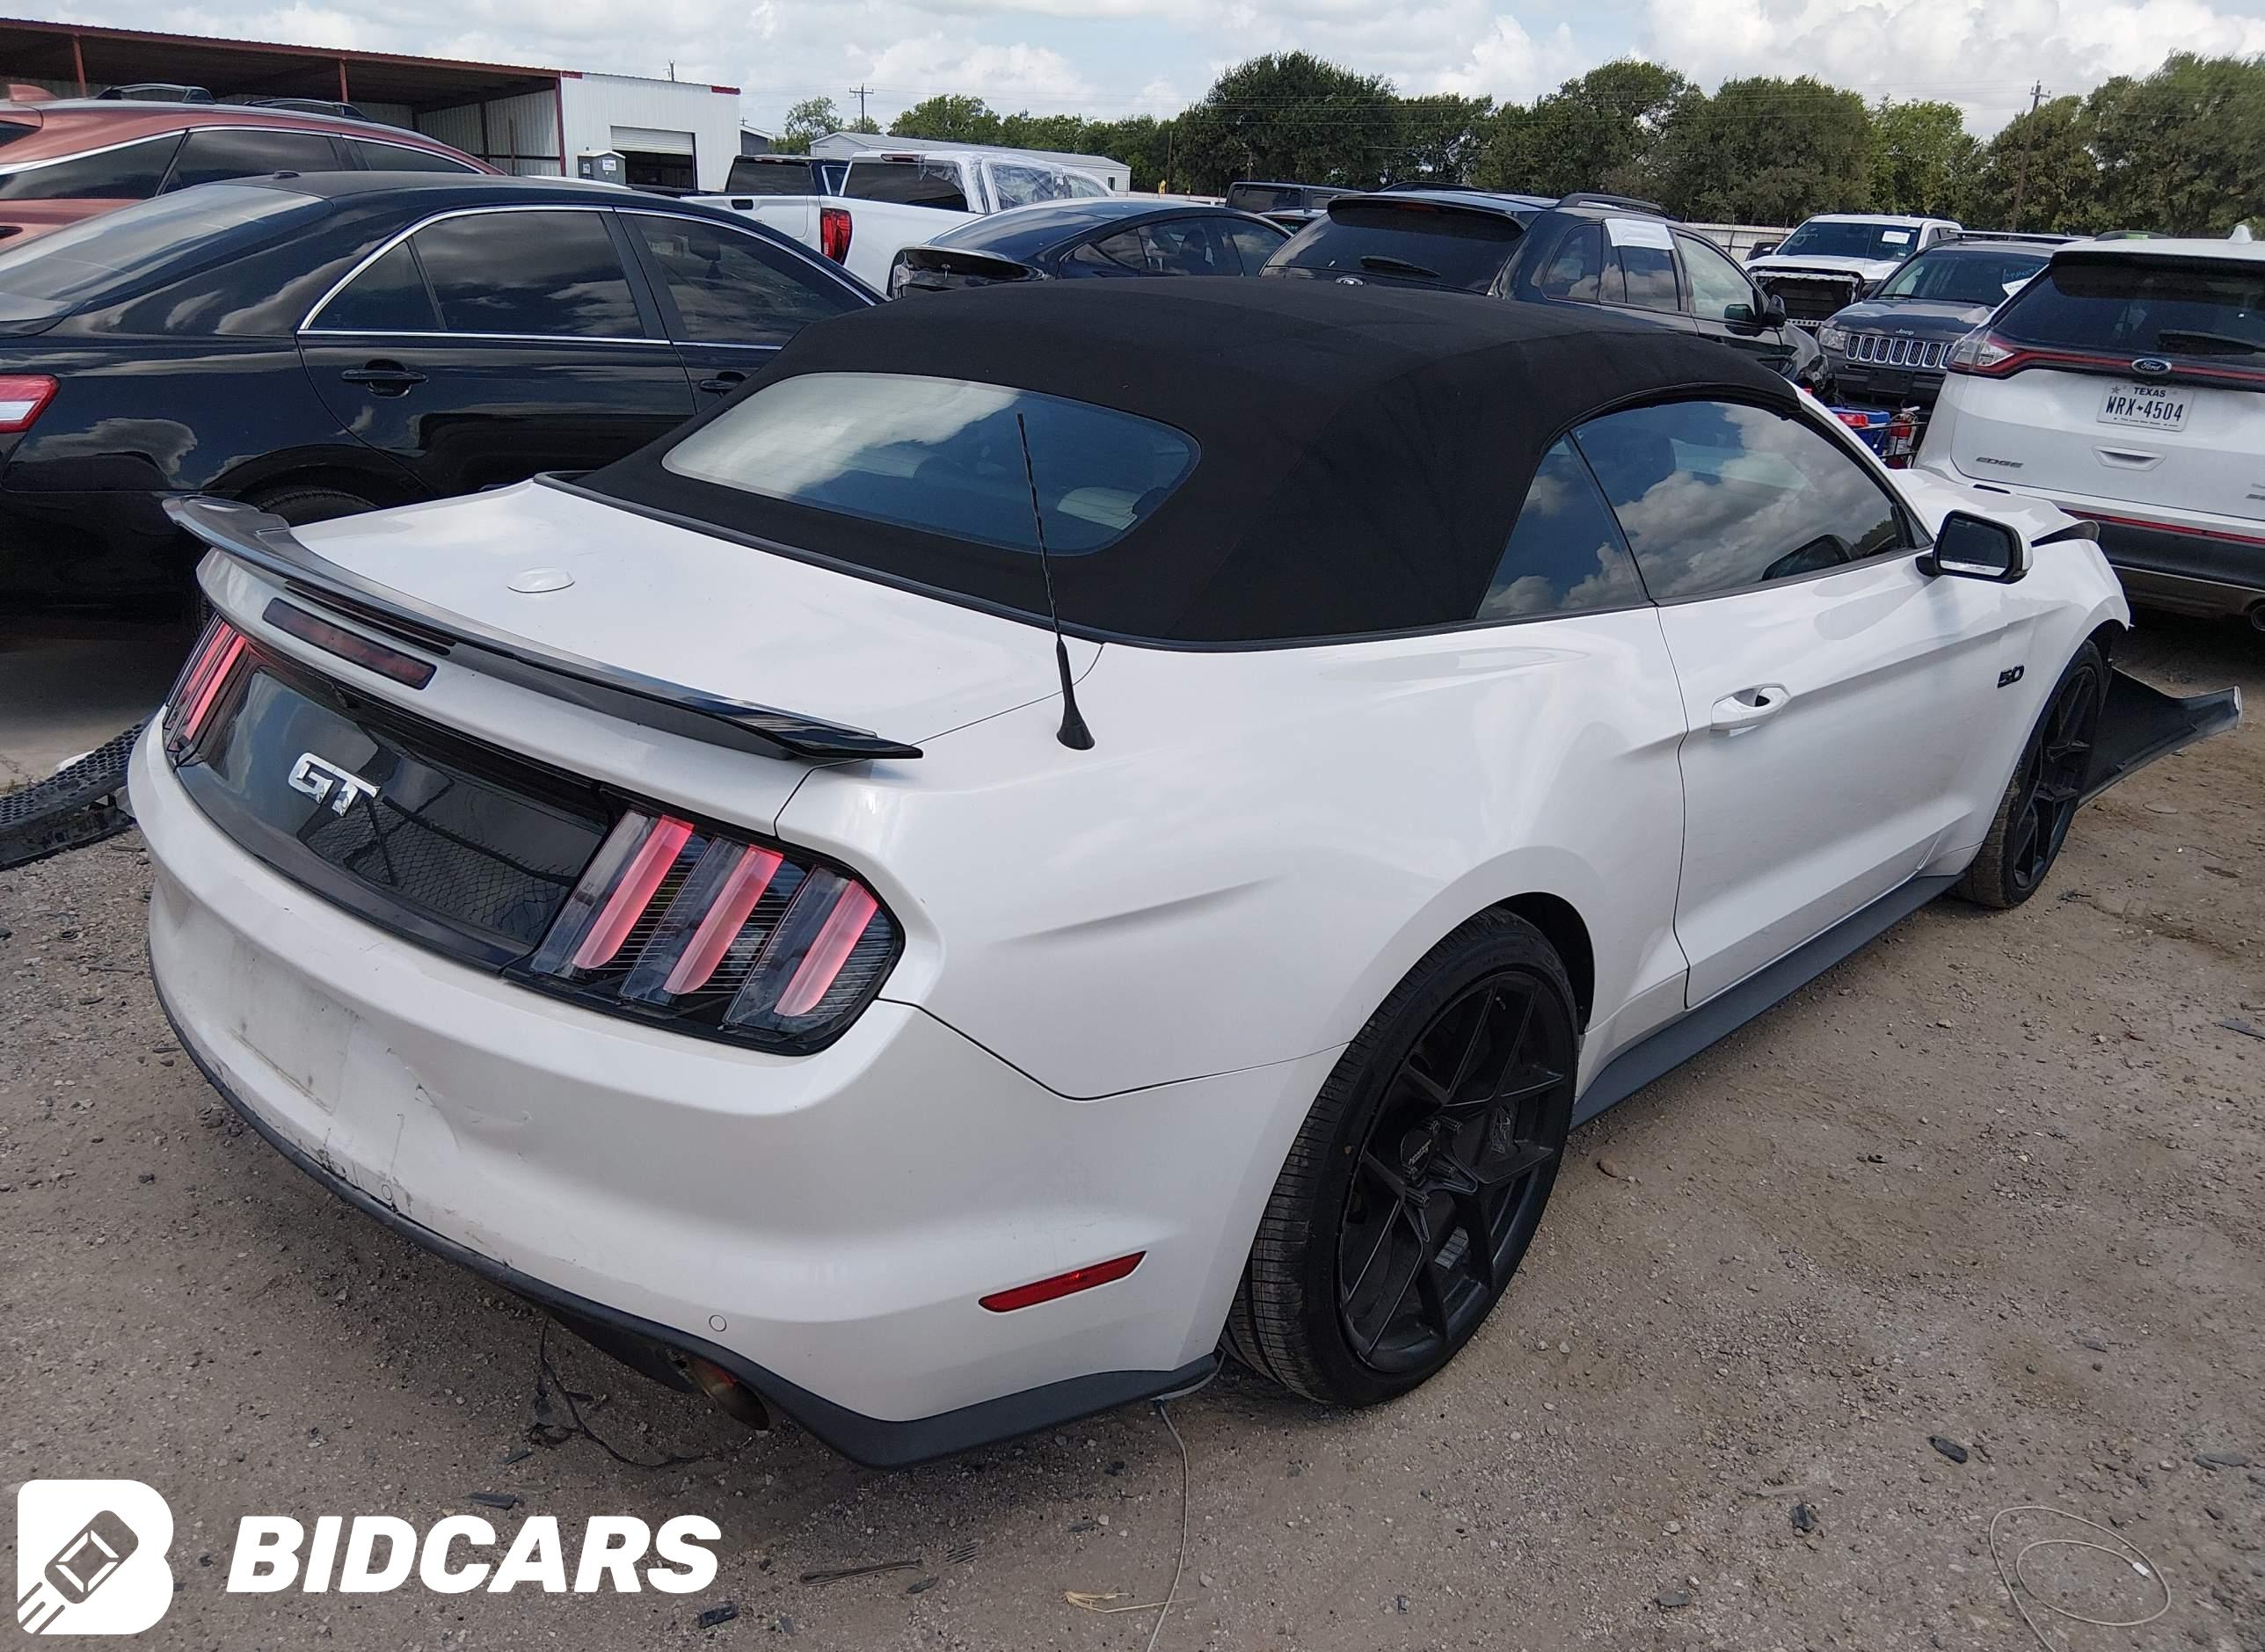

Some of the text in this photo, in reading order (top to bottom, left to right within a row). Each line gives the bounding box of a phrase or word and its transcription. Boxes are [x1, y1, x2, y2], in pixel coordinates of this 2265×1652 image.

[2134, 387, 2167, 398] TEXAS
[1976, 456, 2024, 469] EDGE
[288, 752, 382, 817] GT
